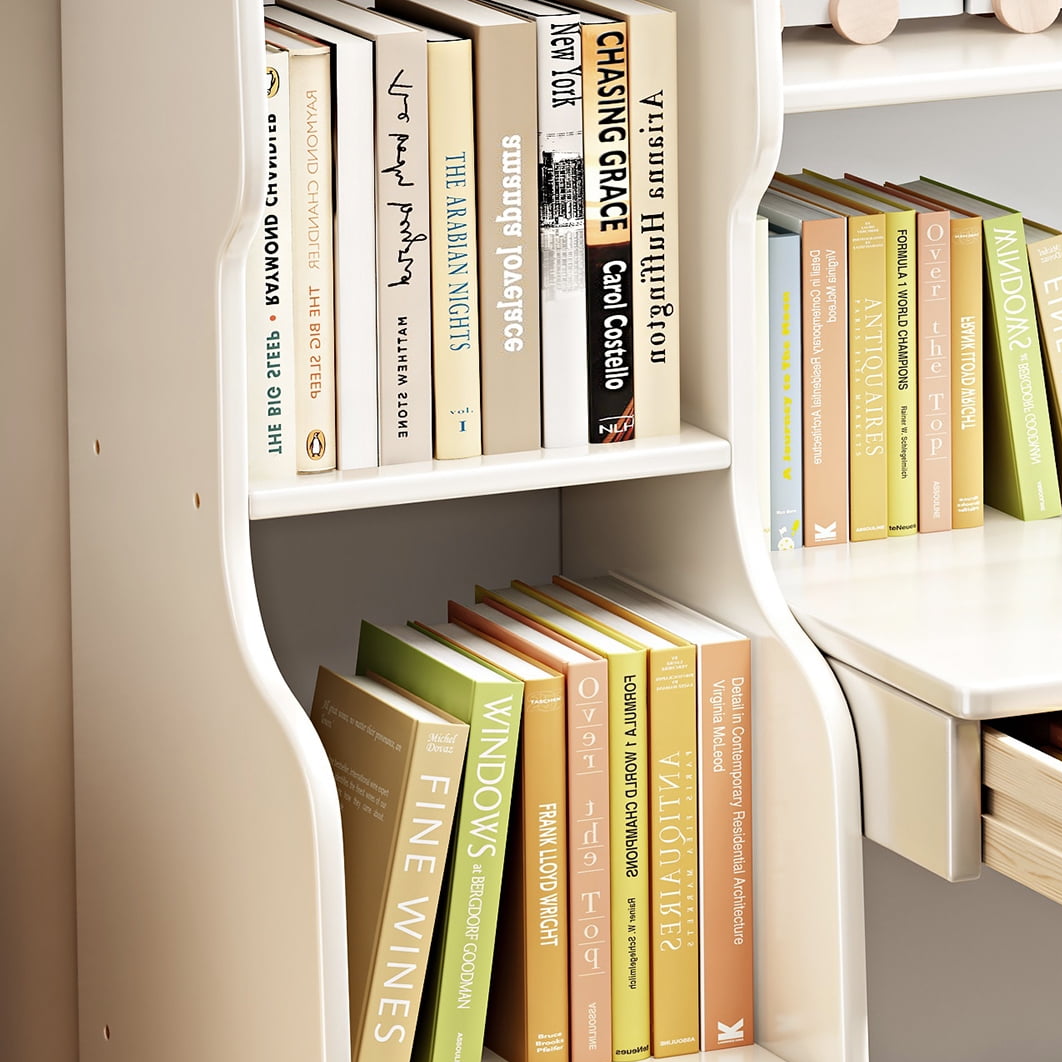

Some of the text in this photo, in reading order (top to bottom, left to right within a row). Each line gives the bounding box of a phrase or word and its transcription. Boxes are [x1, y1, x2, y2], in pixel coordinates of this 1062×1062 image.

[550, 22, 582, 108] New York
[596, 30, 628, 233] CHASING GRACE
[445, 152, 471, 352] THE ARABIAN NIGHTS
[896, 229, 908, 280] FORMULA
[926, 224, 944, 297] Over
[602, 260, 629, 391] Carol Costello
[896, 290, 908, 328] WORLD
[930, 322, 945, 374] the
[861, 298, 884, 456] ANTIQUAIRES
[896, 330, 908, 391] CHAMPIONS
[900, 436, 908, 479] Schlegelmilch
[928, 392, 946, 458] Top
[712, 681, 725, 773] Virginia McLeod
[469, 694, 514, 858] WINDOWS
[730, 676, 744, 946] Detail in Contemporary Residential Architecture
[374, 773, 451, 1045] FINE WINES
[466, 876, 484, 941] BERGDORF
[538, 802, 559, 947] FRANK LLOYD WRIGHT
[456, 943, 478, 1010] GOODMAN
